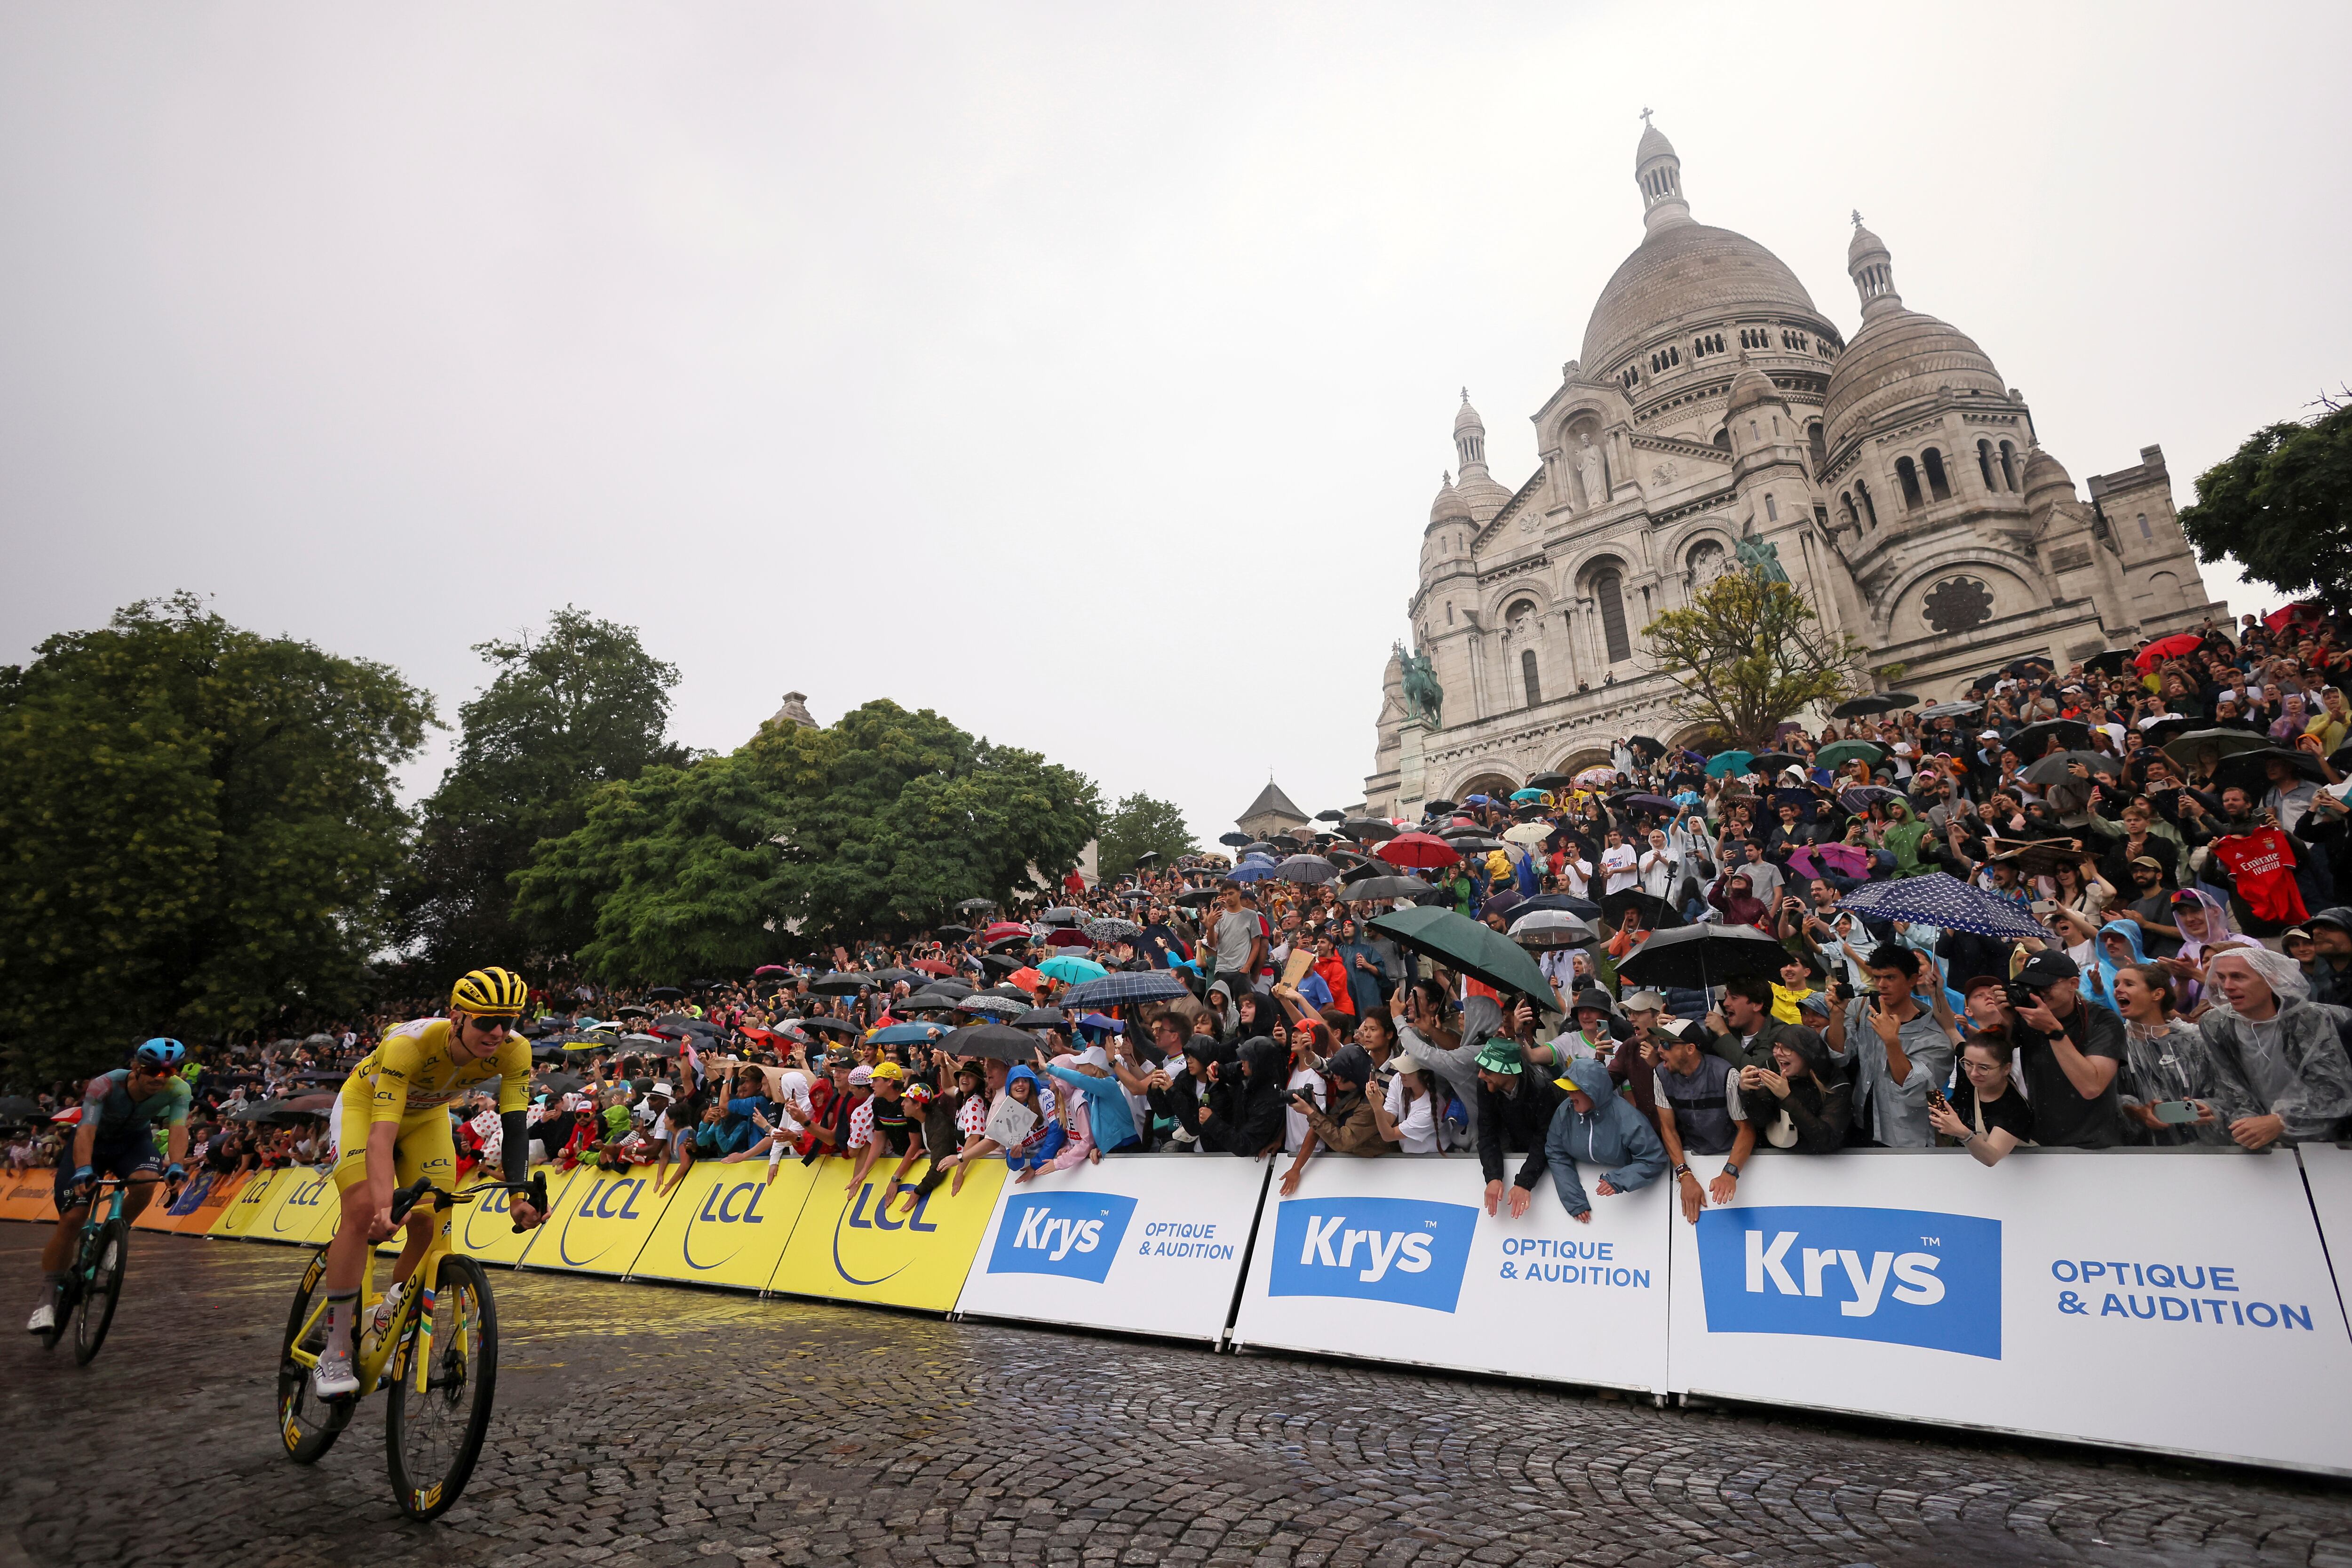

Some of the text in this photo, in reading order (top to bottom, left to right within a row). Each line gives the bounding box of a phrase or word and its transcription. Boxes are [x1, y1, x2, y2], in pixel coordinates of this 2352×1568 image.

[2240, 852, 2280, 871] Emirate
[2026, 957, 2041, 968] P
[464, 982, 482, 999] MET
[373, 1091, 397, 1101] LCL
[423, 1158, 452, 1169] LCL
[241, 1181, 271, 1204] LCL
[288, 1181, 328, 1206] LCL
[480, 1187, 510, 1213] LC
[579, 1178, 646, 1219] LCL
[700, 1183, 766, 1224] LCL
[849, 1183, 937, 1232] LCL
[1013, 1207, 1104, 1261] Krys
[1144, 1222, 1217, 1240] OPTIQUE
[1138, 1241, 1235, 1261] & AUDITION
[1300, 1215, 1435, 1283] Krys
[1502, 1237, 1614, 1261] OPTIQUE
[1500, 1261, 1651, 1289] & AUDITION
[1745, 1229, 1946, 1318] Krys
[2051, 1259, 2240, 1292] OPTIQUE
[376, 1274, 417, 1352] COLNAGO
[2058, 1290, 2314, 1331] & AUDITION
